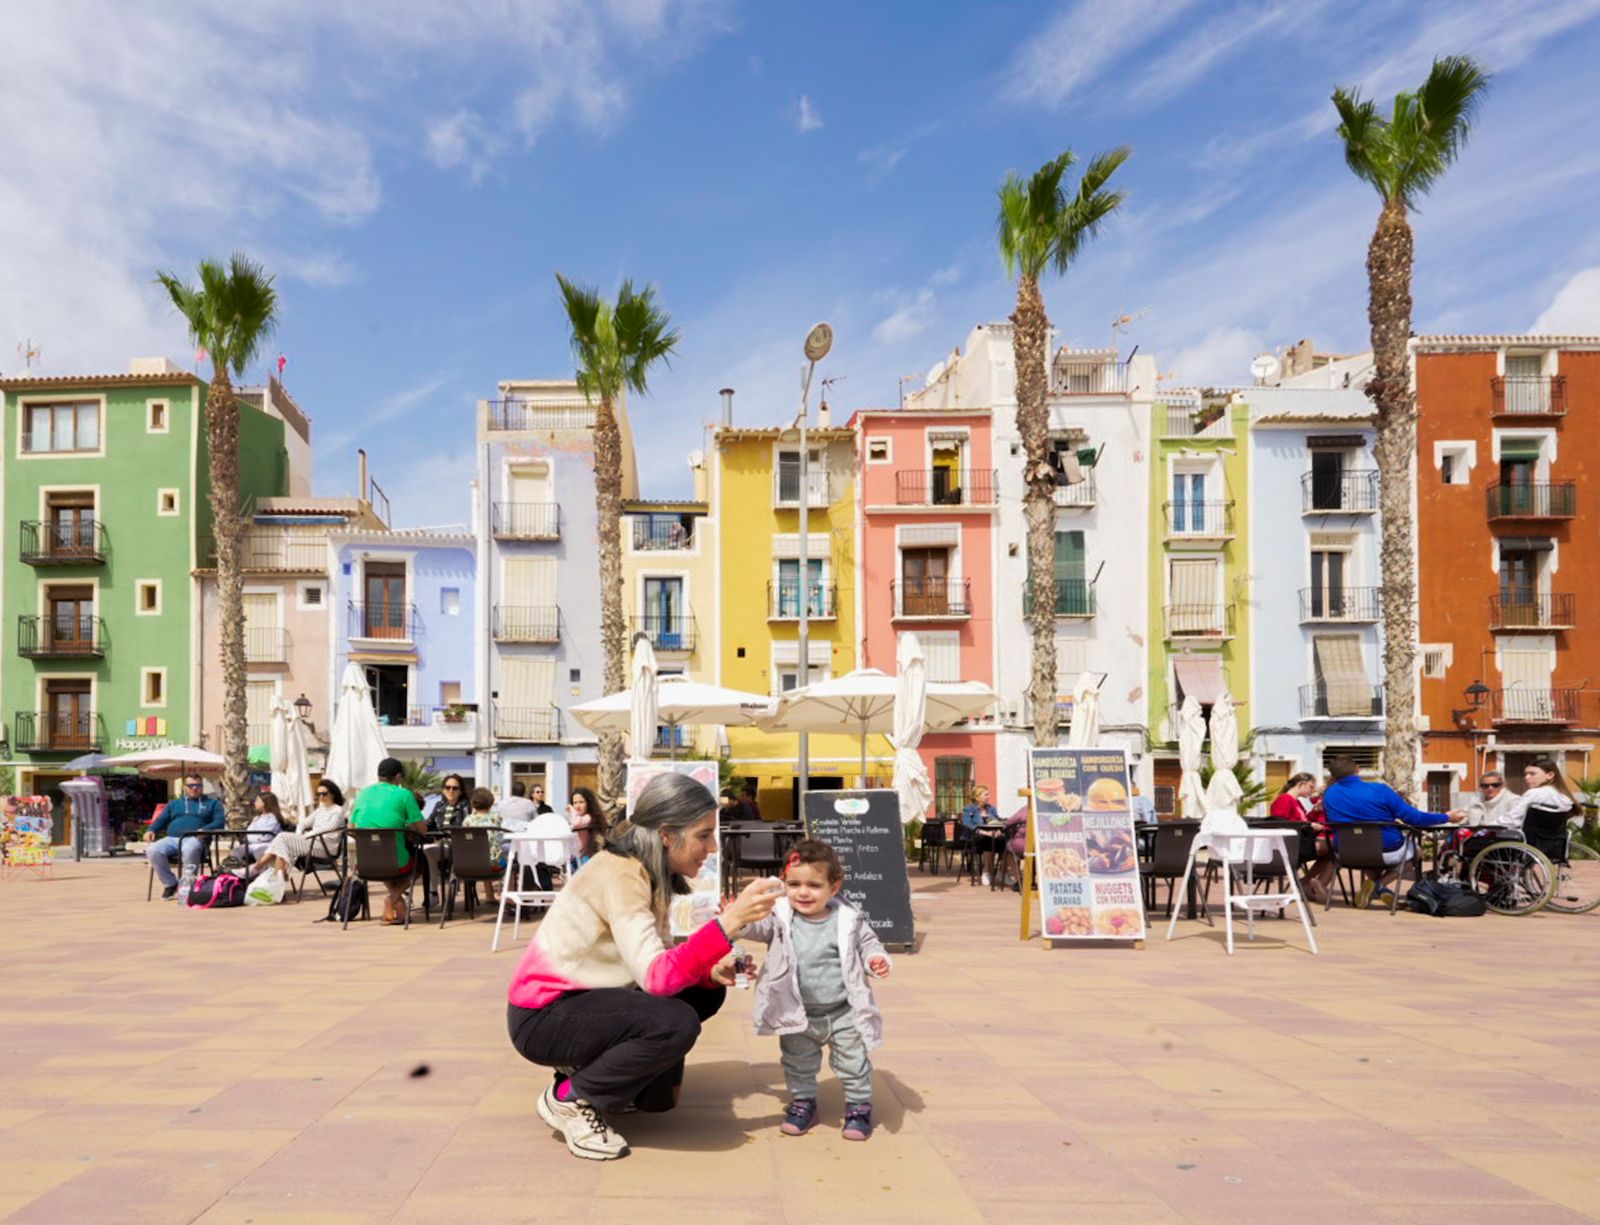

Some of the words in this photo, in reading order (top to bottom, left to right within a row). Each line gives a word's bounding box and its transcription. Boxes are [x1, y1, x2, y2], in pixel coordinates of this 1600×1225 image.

[1049, 883, 1083, 895] PATATAS
[1094, 883, 1134, 895] NUGGETS
[1053, 896, 1081, 906] BRAVAS
[1096, 896, 1109, 905] CON
